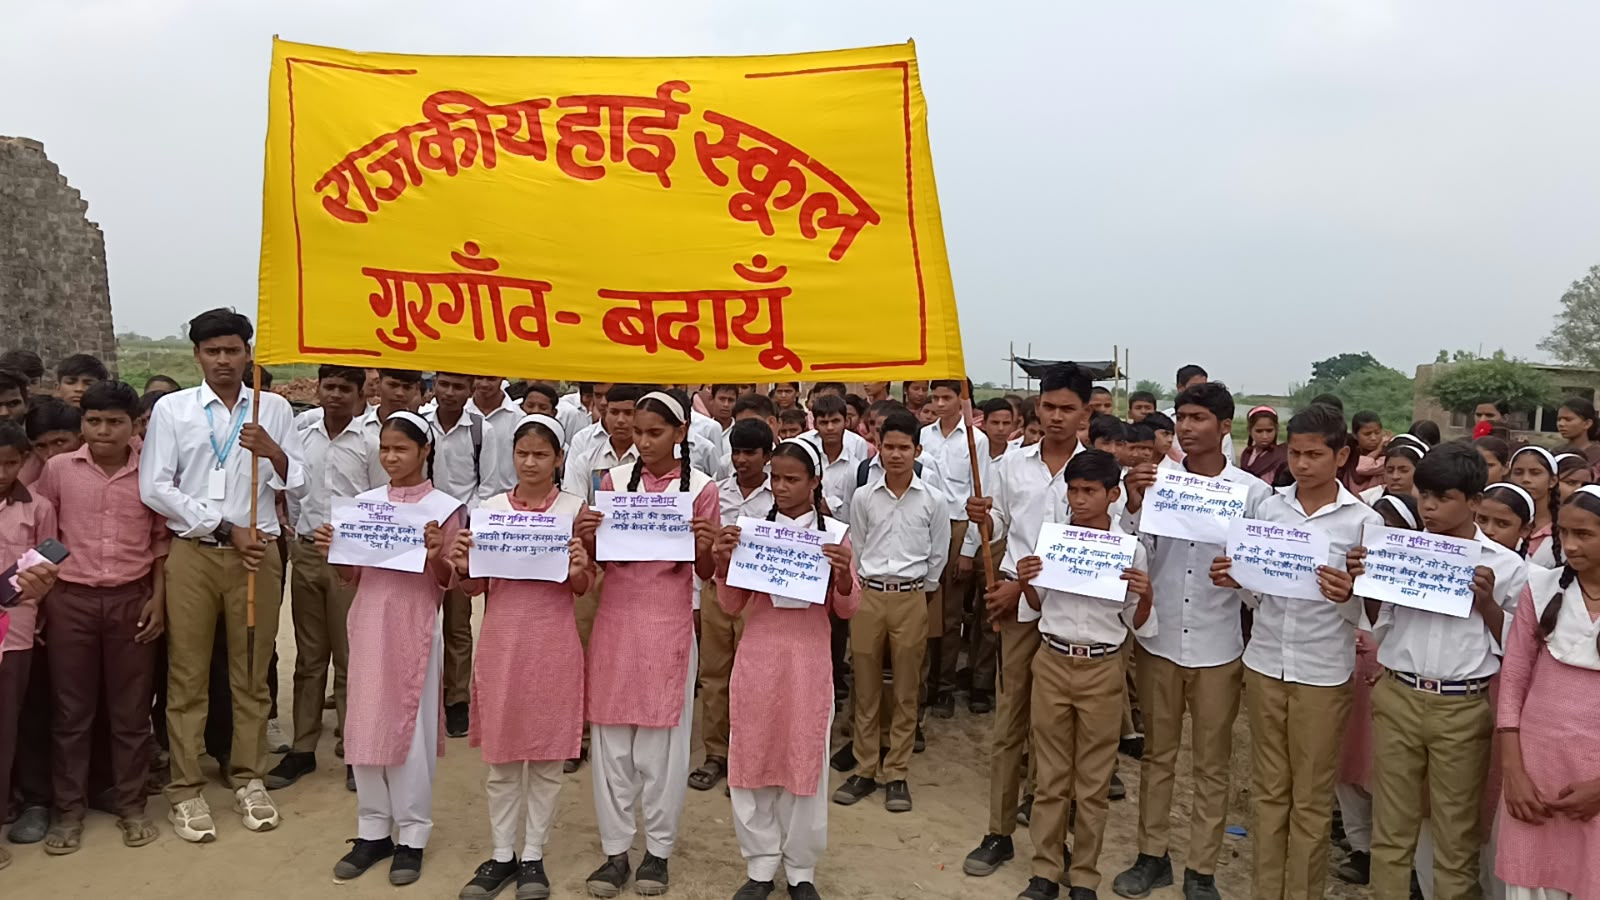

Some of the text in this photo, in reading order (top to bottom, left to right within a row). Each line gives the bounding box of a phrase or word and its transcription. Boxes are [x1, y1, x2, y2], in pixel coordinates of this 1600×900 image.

[314, 80, 880, 261] राजकीय हाई स्कूल
[597, 254, 802, 373] बदायूँ
[1184, 475, 1206, 485] मुक्ति
[630, 495, 649, 505] मुक्ति
[358, 502, 396, 514] नशा मुक्ति
[508, 514, 528, 524] मुक्ति
[755, 525, 771, 534] नशा
[775, 527, 795, 539] मुक्ति
[1079, 531, 1098, 540] मुक्ति
[1246, 525, 1261, 534] नशा
[1264, 526, 1284, 536] मुक्ति
[1387, 533, 1404, 543] नशा
[1407, 536, 1433, 547] मुक्ति
